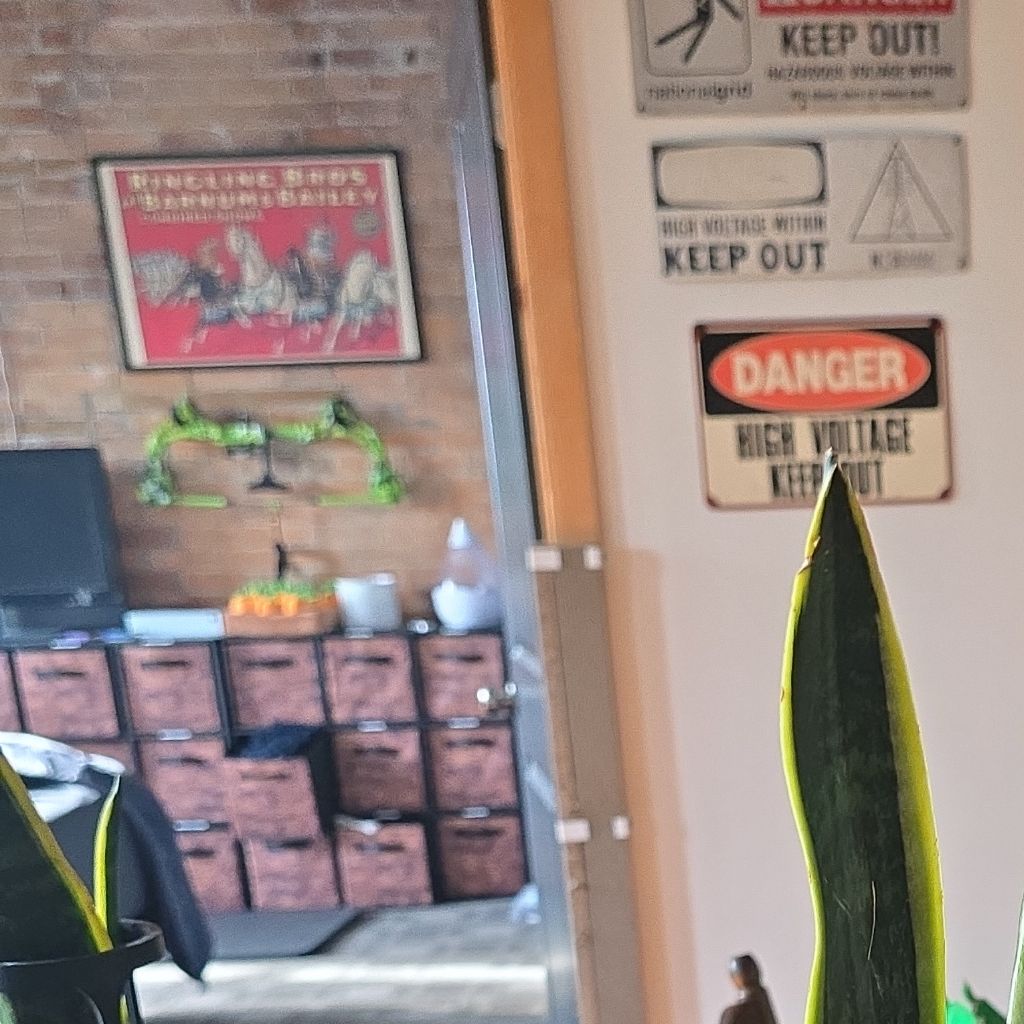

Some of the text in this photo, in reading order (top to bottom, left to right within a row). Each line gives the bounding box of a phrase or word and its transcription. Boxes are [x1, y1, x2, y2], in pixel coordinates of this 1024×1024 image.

[779, 22, 858, 58] KEEP
[664, 242, 825, 276] KEEP OUT
[733, 348, 909, 396] DANGER
[736, 416, 913, 458] HIGH VOLTAGE
